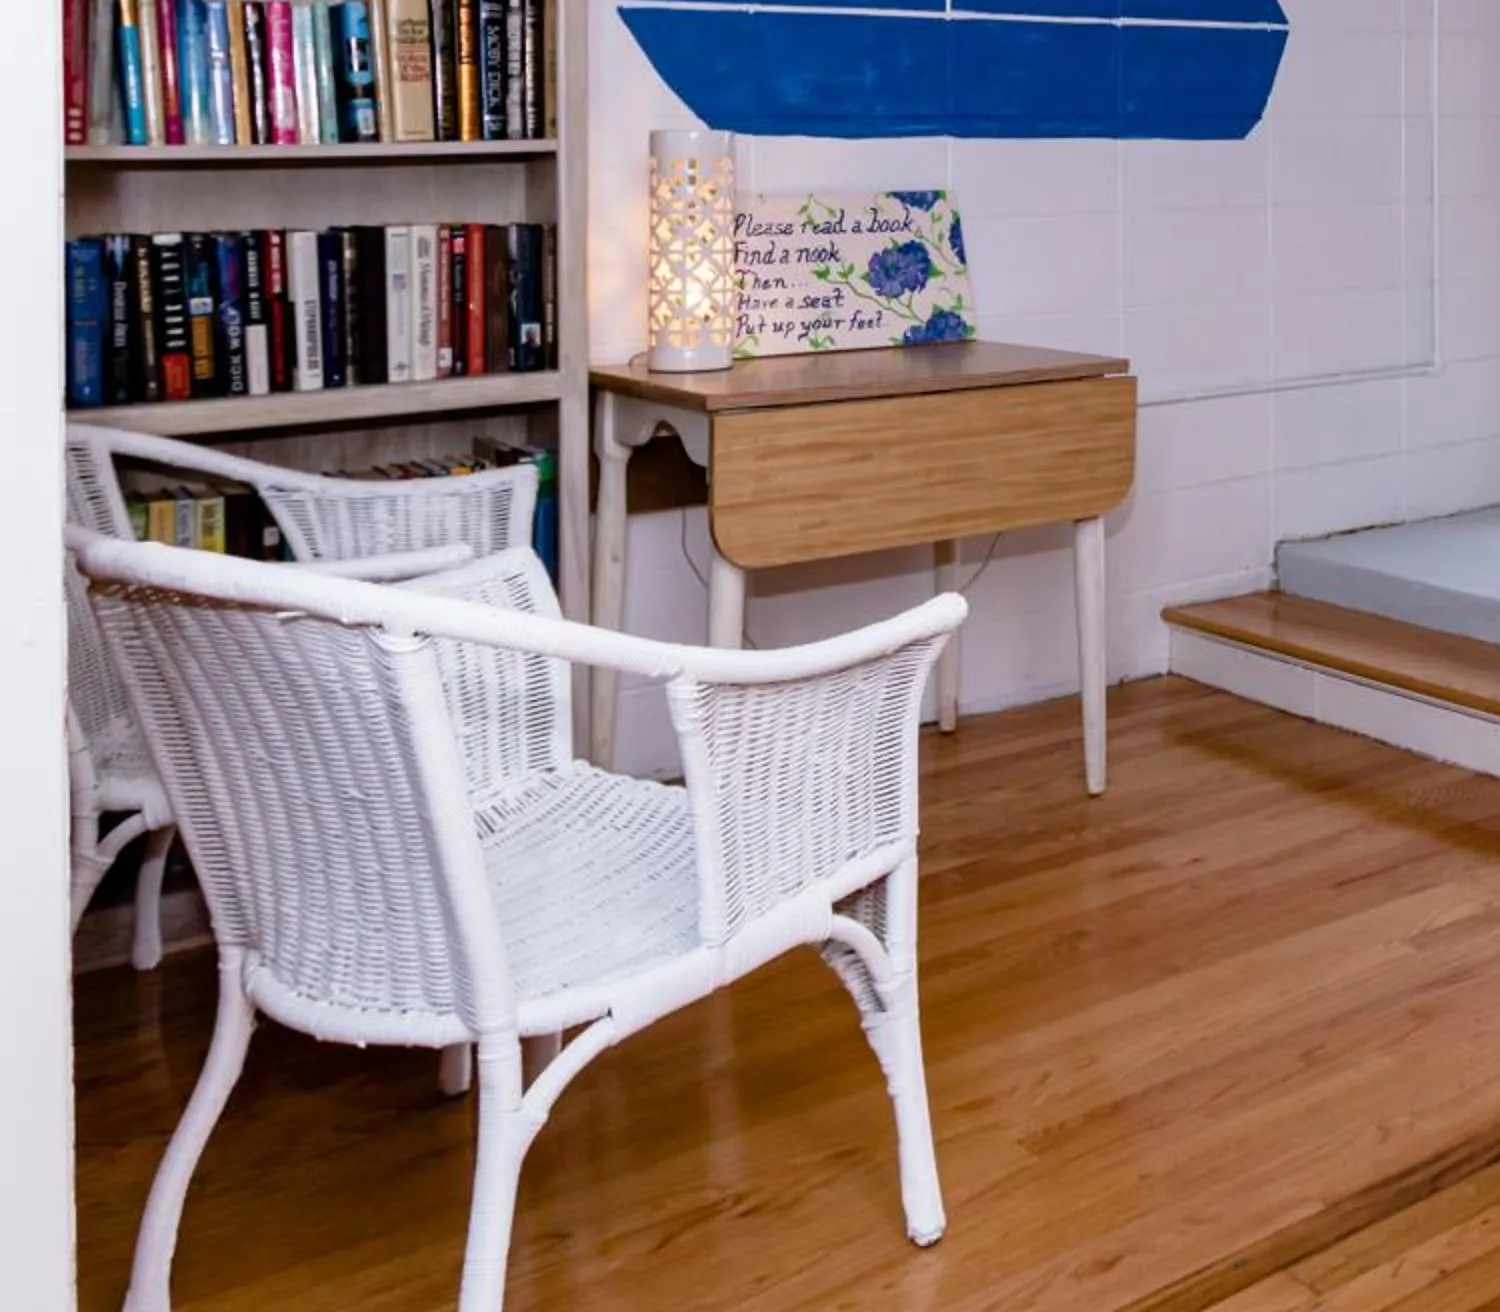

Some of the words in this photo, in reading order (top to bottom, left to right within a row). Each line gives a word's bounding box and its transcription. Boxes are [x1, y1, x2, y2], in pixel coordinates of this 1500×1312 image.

[733, 214, 794, 237] Please
[801, 209, 847, 234] read
[851, 220, 864, 234] a
[866, 207, 914, 234] book
[733, 239, 776, 265] Find
[779, 248, 790, 263] a
[796, 240, 842, 263] nook
[737, 291, 778, 310] Have
[784, 297, 794, 309] a
[797, 288, 845, 309] seat
[736, 315, 766, 338] Put
[772, 320, 796, 339] up
[797, 318, 845, 342] your
[850, 310, 884, 332] feet
[230, 354, 243, 392] DICK
